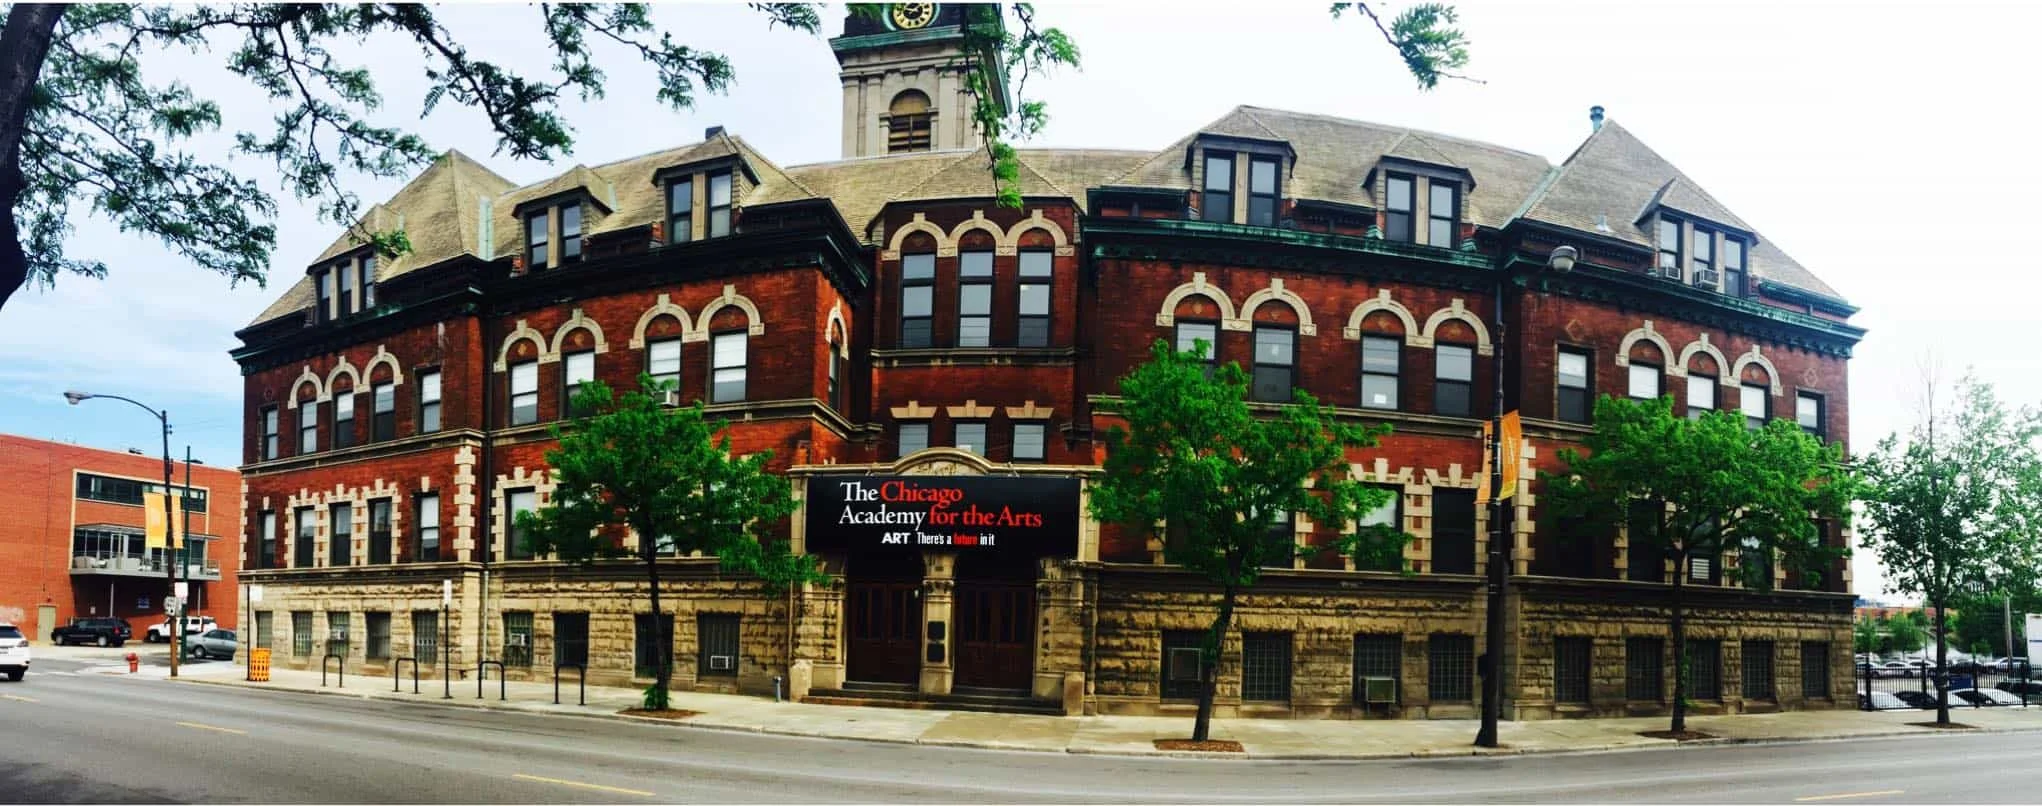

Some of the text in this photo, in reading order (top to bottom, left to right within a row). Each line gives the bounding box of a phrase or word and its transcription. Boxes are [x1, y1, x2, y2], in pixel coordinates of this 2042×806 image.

[840, 480, 963, 508] The Chicago
[839, 503, 1042, 531] Academy for the Arts
[881, 532, 911, 544] ART
[917, 532, 944, 545] There's
[946, 535, 952, 545] a
[980, 533, 988, 546] in
[988, 533, 996, 546] it
